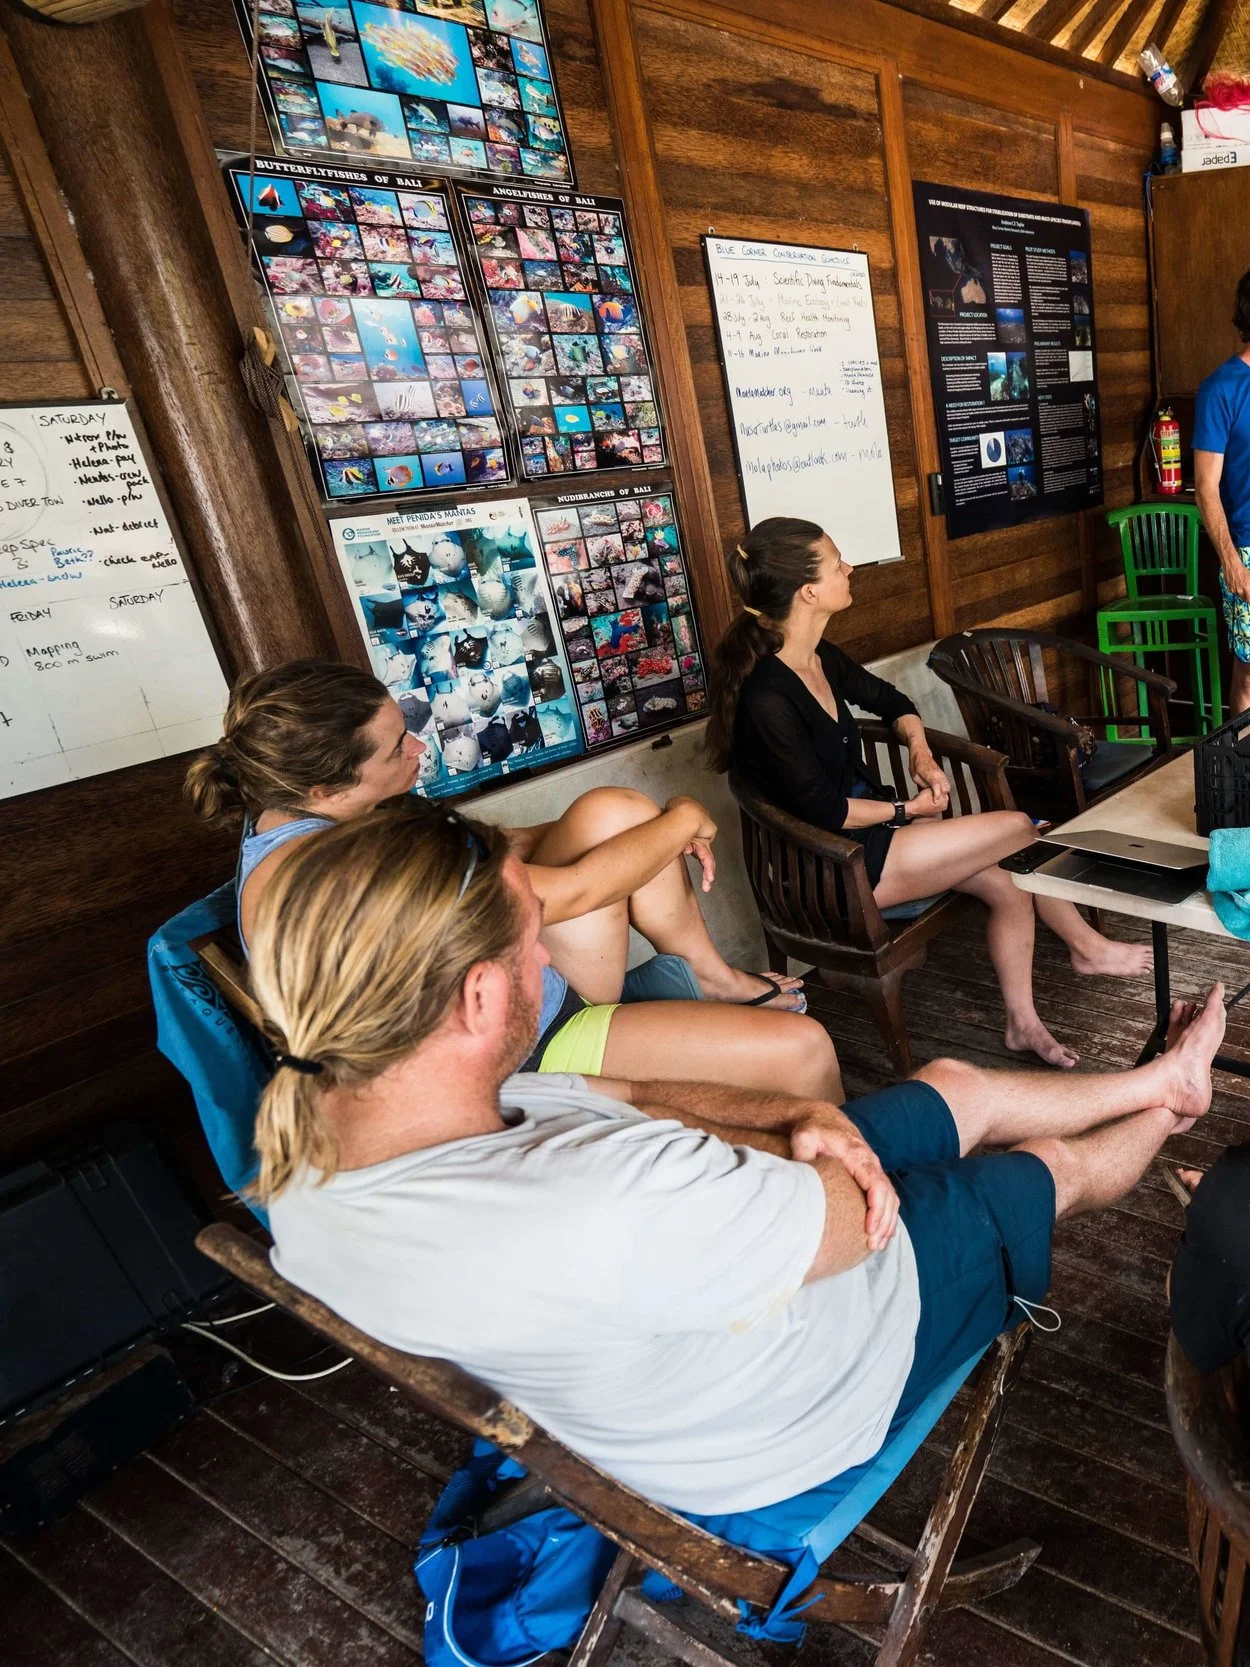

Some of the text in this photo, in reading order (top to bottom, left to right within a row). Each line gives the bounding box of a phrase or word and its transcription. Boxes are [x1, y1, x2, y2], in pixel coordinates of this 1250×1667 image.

[1201, 151, 1238, 166] Epaper
[255, 159, 423, 188] BUTTERFLYFISHES OF BALI
[493, 187, 596, 206] ANGELFISHES OF BALI
[715, 243, 851, 265] BLUE CORNER CONSERVATION SCHEDULE
[773, 270, 804, 287] Scientific
[40, 412, 106, 427] SATURDAY
[5, 494, 65, 512] DIVER TOW
[557, 485, 653, 503] NUDIBRANCHS OF BALI
[386, 507, 476, 526] MEET PENIDA'S MANTAS
[109, 589, 164, 610] SATURDAY
[10, 607, 52, 623] FRIDAY
[26, 640, 83, 658] Mapping
[34, 660, 63, 671] 800
[86, 649, 119, 662] swim
